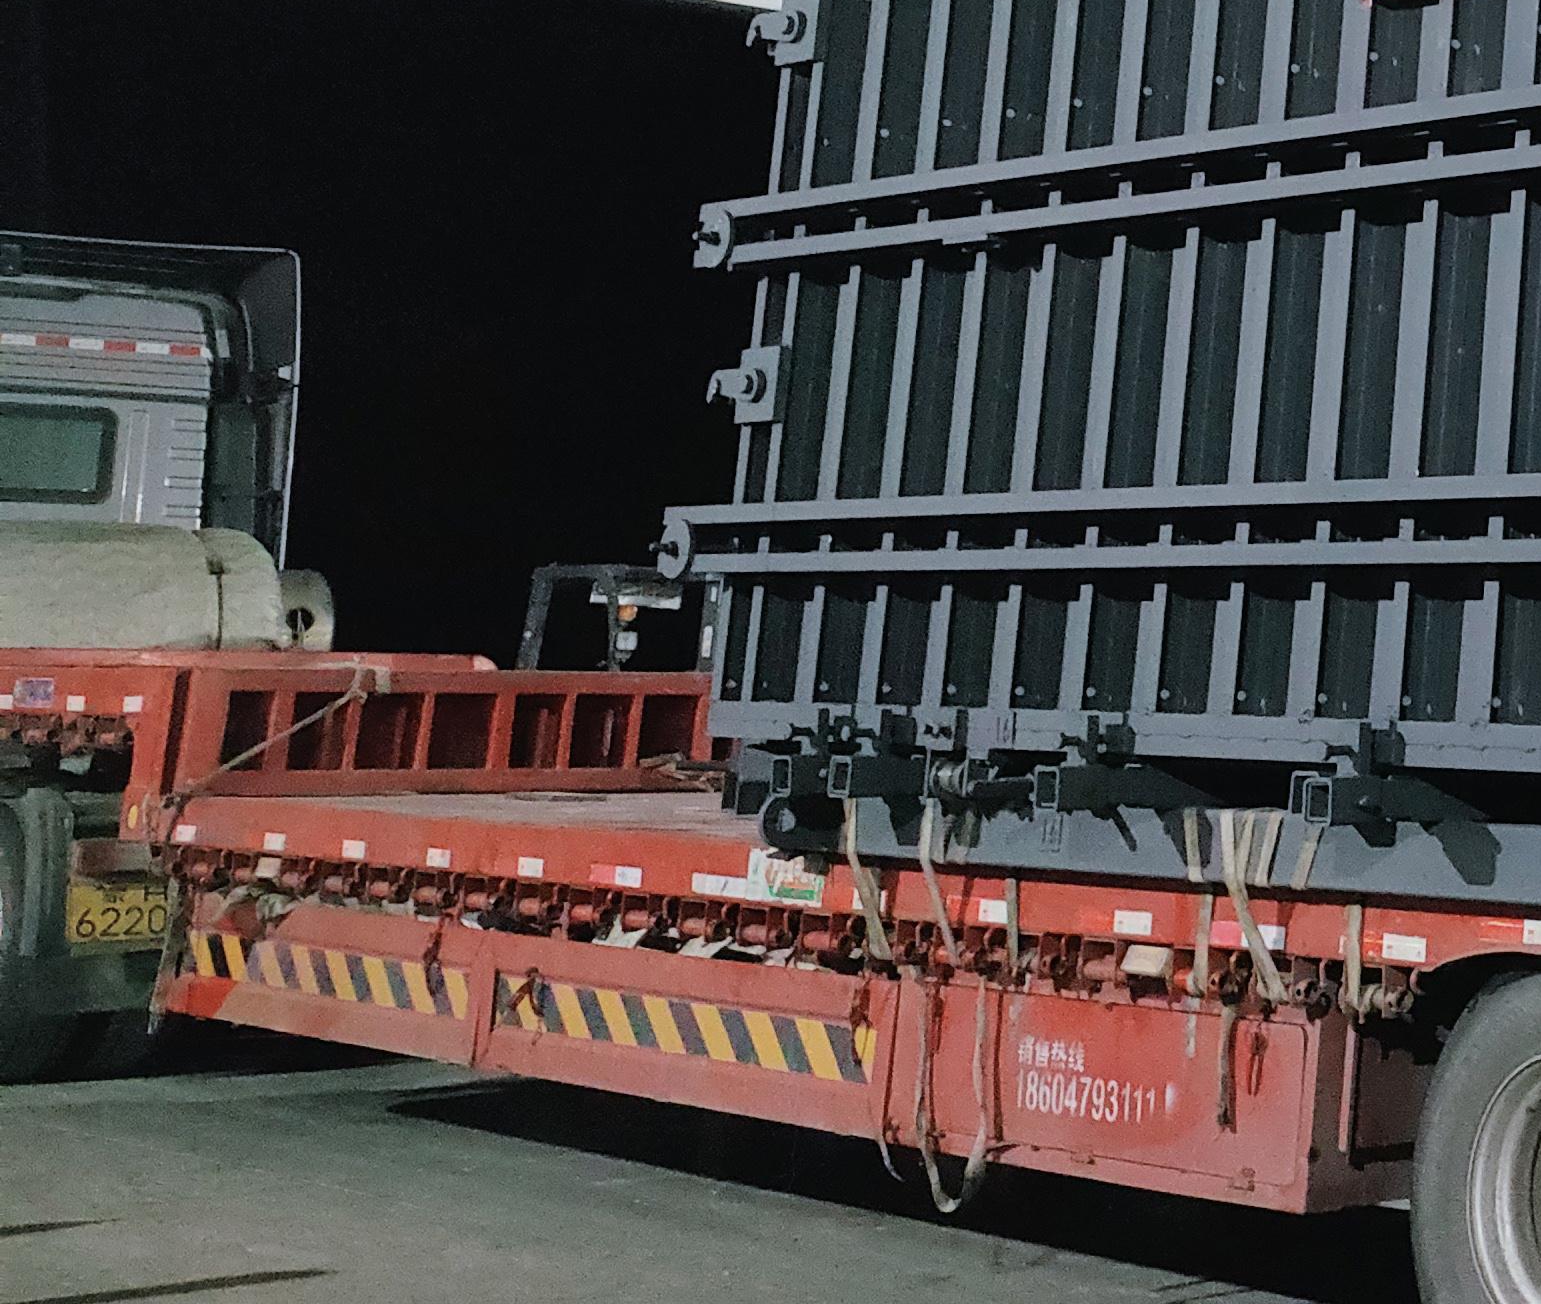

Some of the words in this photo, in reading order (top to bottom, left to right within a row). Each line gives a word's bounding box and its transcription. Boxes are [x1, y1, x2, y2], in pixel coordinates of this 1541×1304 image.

[75, 904, 168, 938] 6220
[1017, 1034, 1085, 1073] 销售热线
